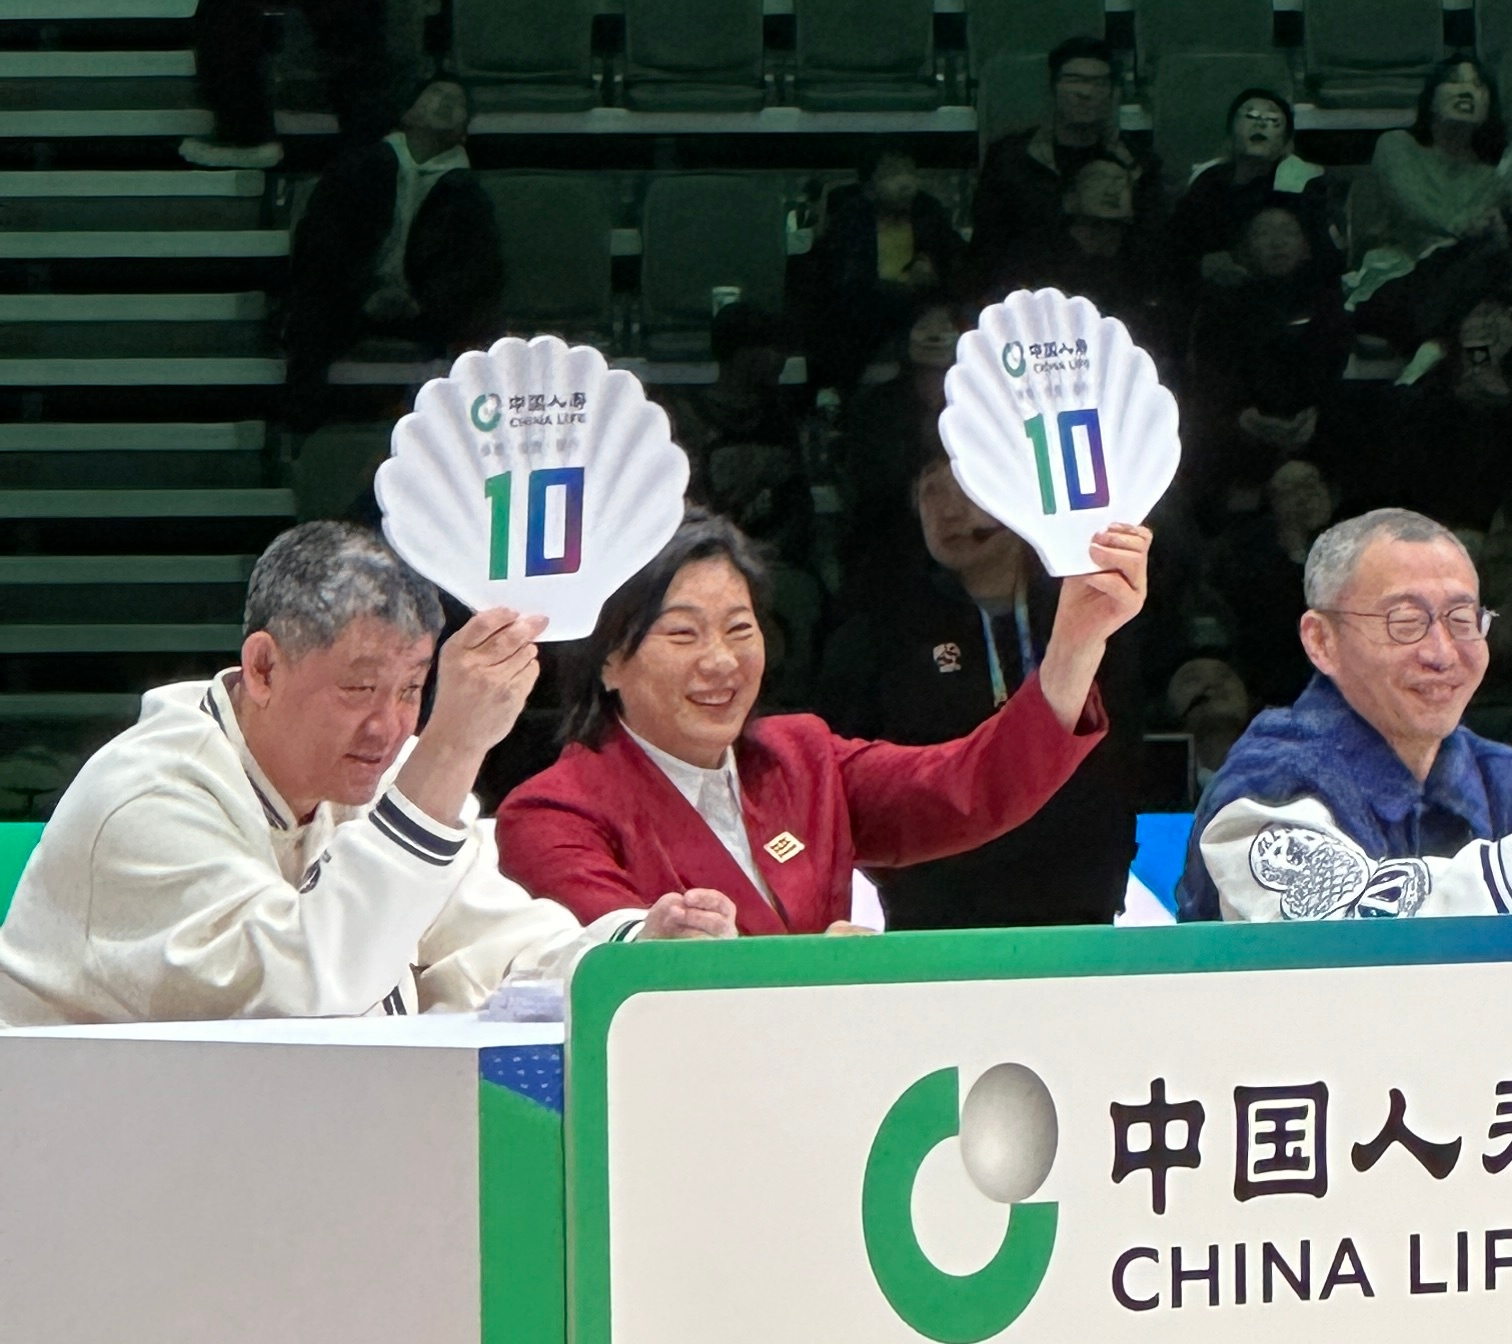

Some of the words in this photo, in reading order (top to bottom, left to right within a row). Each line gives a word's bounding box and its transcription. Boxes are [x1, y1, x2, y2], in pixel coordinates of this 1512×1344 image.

[508, 391, 587, 413] 中国人寿
[1024, 408, 1110, 516] 10
[484, 466, 585, 581] 10
[1111, 1238, 1375, 1312] CHINA
